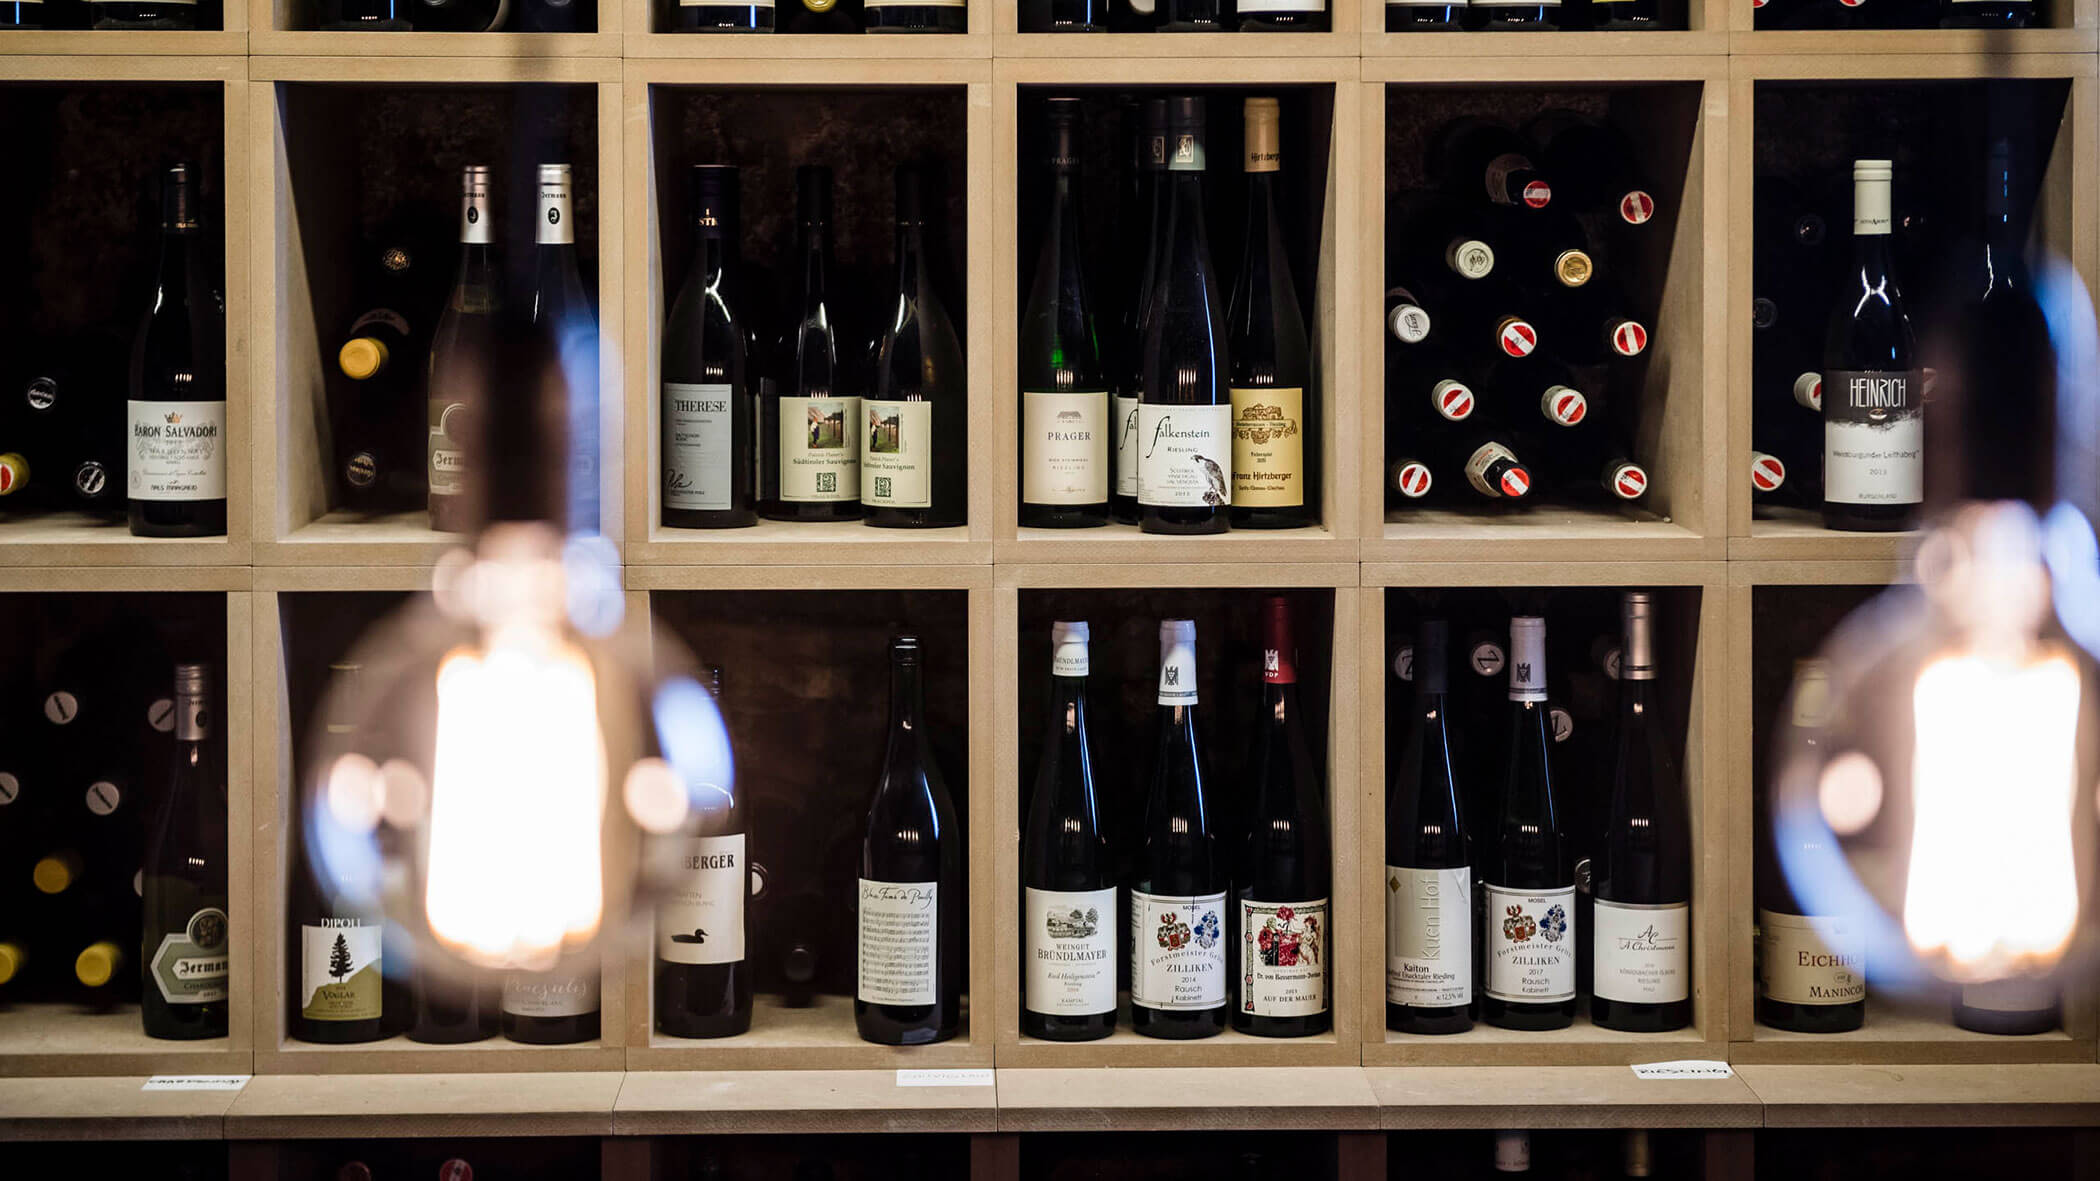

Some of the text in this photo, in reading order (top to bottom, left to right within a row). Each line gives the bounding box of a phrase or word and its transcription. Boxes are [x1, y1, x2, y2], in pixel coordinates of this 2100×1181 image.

[1850, 378, 1906, 408] HEINRICH
[675, 400, 727, 412] THERESE
[165, 425, 218, 438] SALVADORI
[1047, 431, 1092, 441] PRAGER
[826, 457, 857, 467] Sauvignon
[1253, 471, 1292, 481] Hirtzberger
[1037, 949, 1107, 960] BRÜNDLMAYER
[1497, 944, 1553, 958] Forstmeister
[1151, 951, 1206, 966] Forstmeister
[1512, 956, 1560, 966] ZILLIKEN
[1166, 963, 1214, 973] ZILLIKEN
[1403, 963, 1429, 973] Kaiton
[1521, 977, 1551, 985] Rausch
[1174, 985, 1203, 993] Rausch
[321, 990, 355, 1000] VOGLAR
